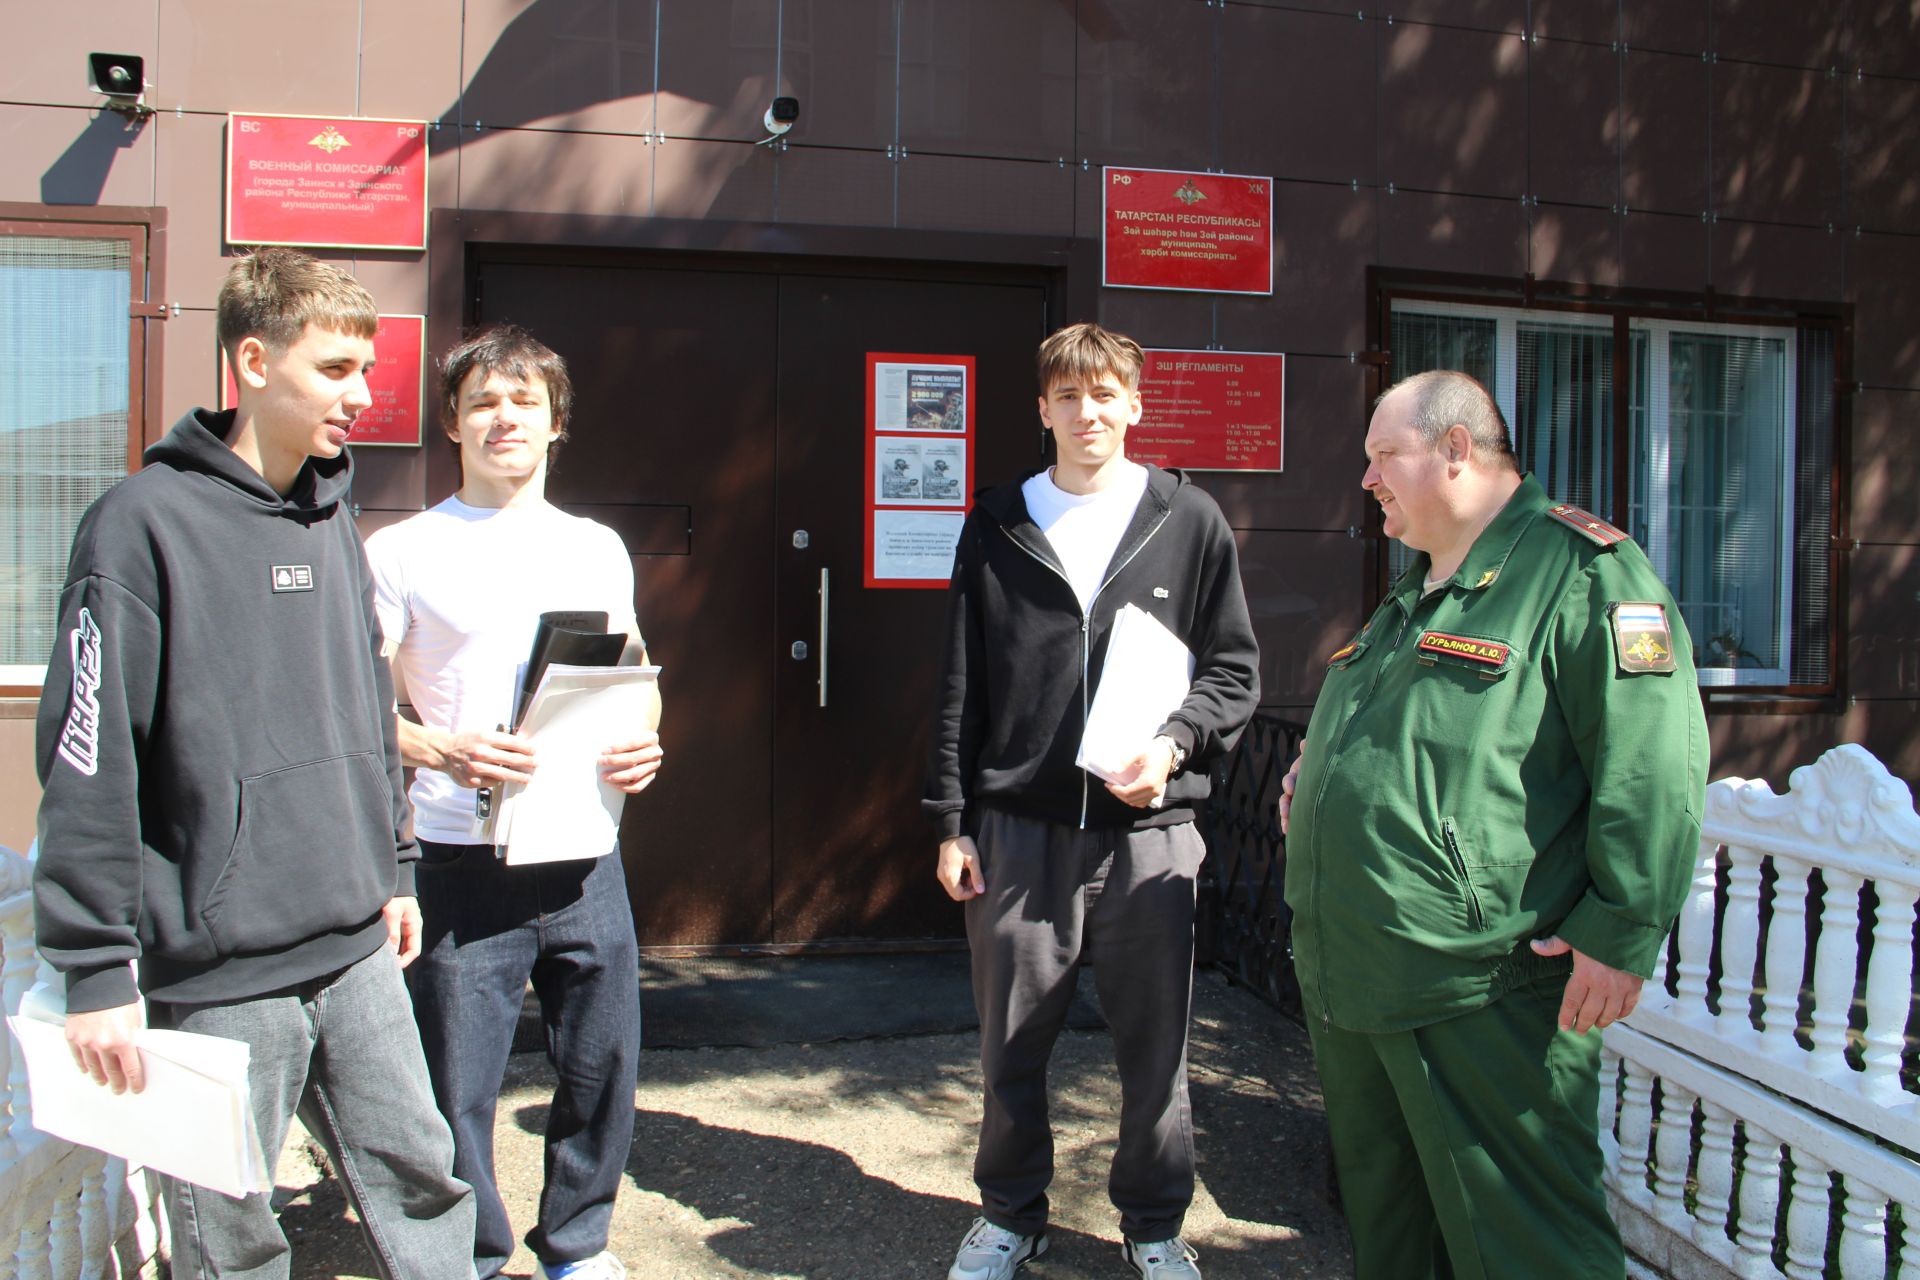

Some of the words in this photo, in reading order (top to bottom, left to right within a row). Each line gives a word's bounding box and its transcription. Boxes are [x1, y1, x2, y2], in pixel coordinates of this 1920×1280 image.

[240, 121, 261, 133] ВС
[397, 127, 419, 138] РФ
[249, 160, 313, 172] ВОЕННЫЙ
[315, 163, 407, 176] КОМИССАРИАТ
[297, 178, 335, 188] Заинск
[348, 180, 402, 191] Заинского
[1113, 174, 1132, 185] РФ
[1248, 184, 1264, 194] ХК
[245, 187, 284, 197] района
[287, 188, 351, 200] Республики
[1115, 210, 1174, 223] ТАТАРСТАН
[1176, 214, 1261, 228] РЕСПУБЛИКАСЫ
[1219, 231, 1254, 241] районы
[1161, 239, 1217, 250] муниципаль
[1171, 250, 1237, 260] комиссариаты
[1156, 361, 1173, 371] ЭШ
[1175, 362, 1244, 373] РЕГЛАМЕНТЫ
[1425, 636, 1477, 653] ГУРЬЯНОВ
[1478, 648, 1500, 659] А.Ю.
